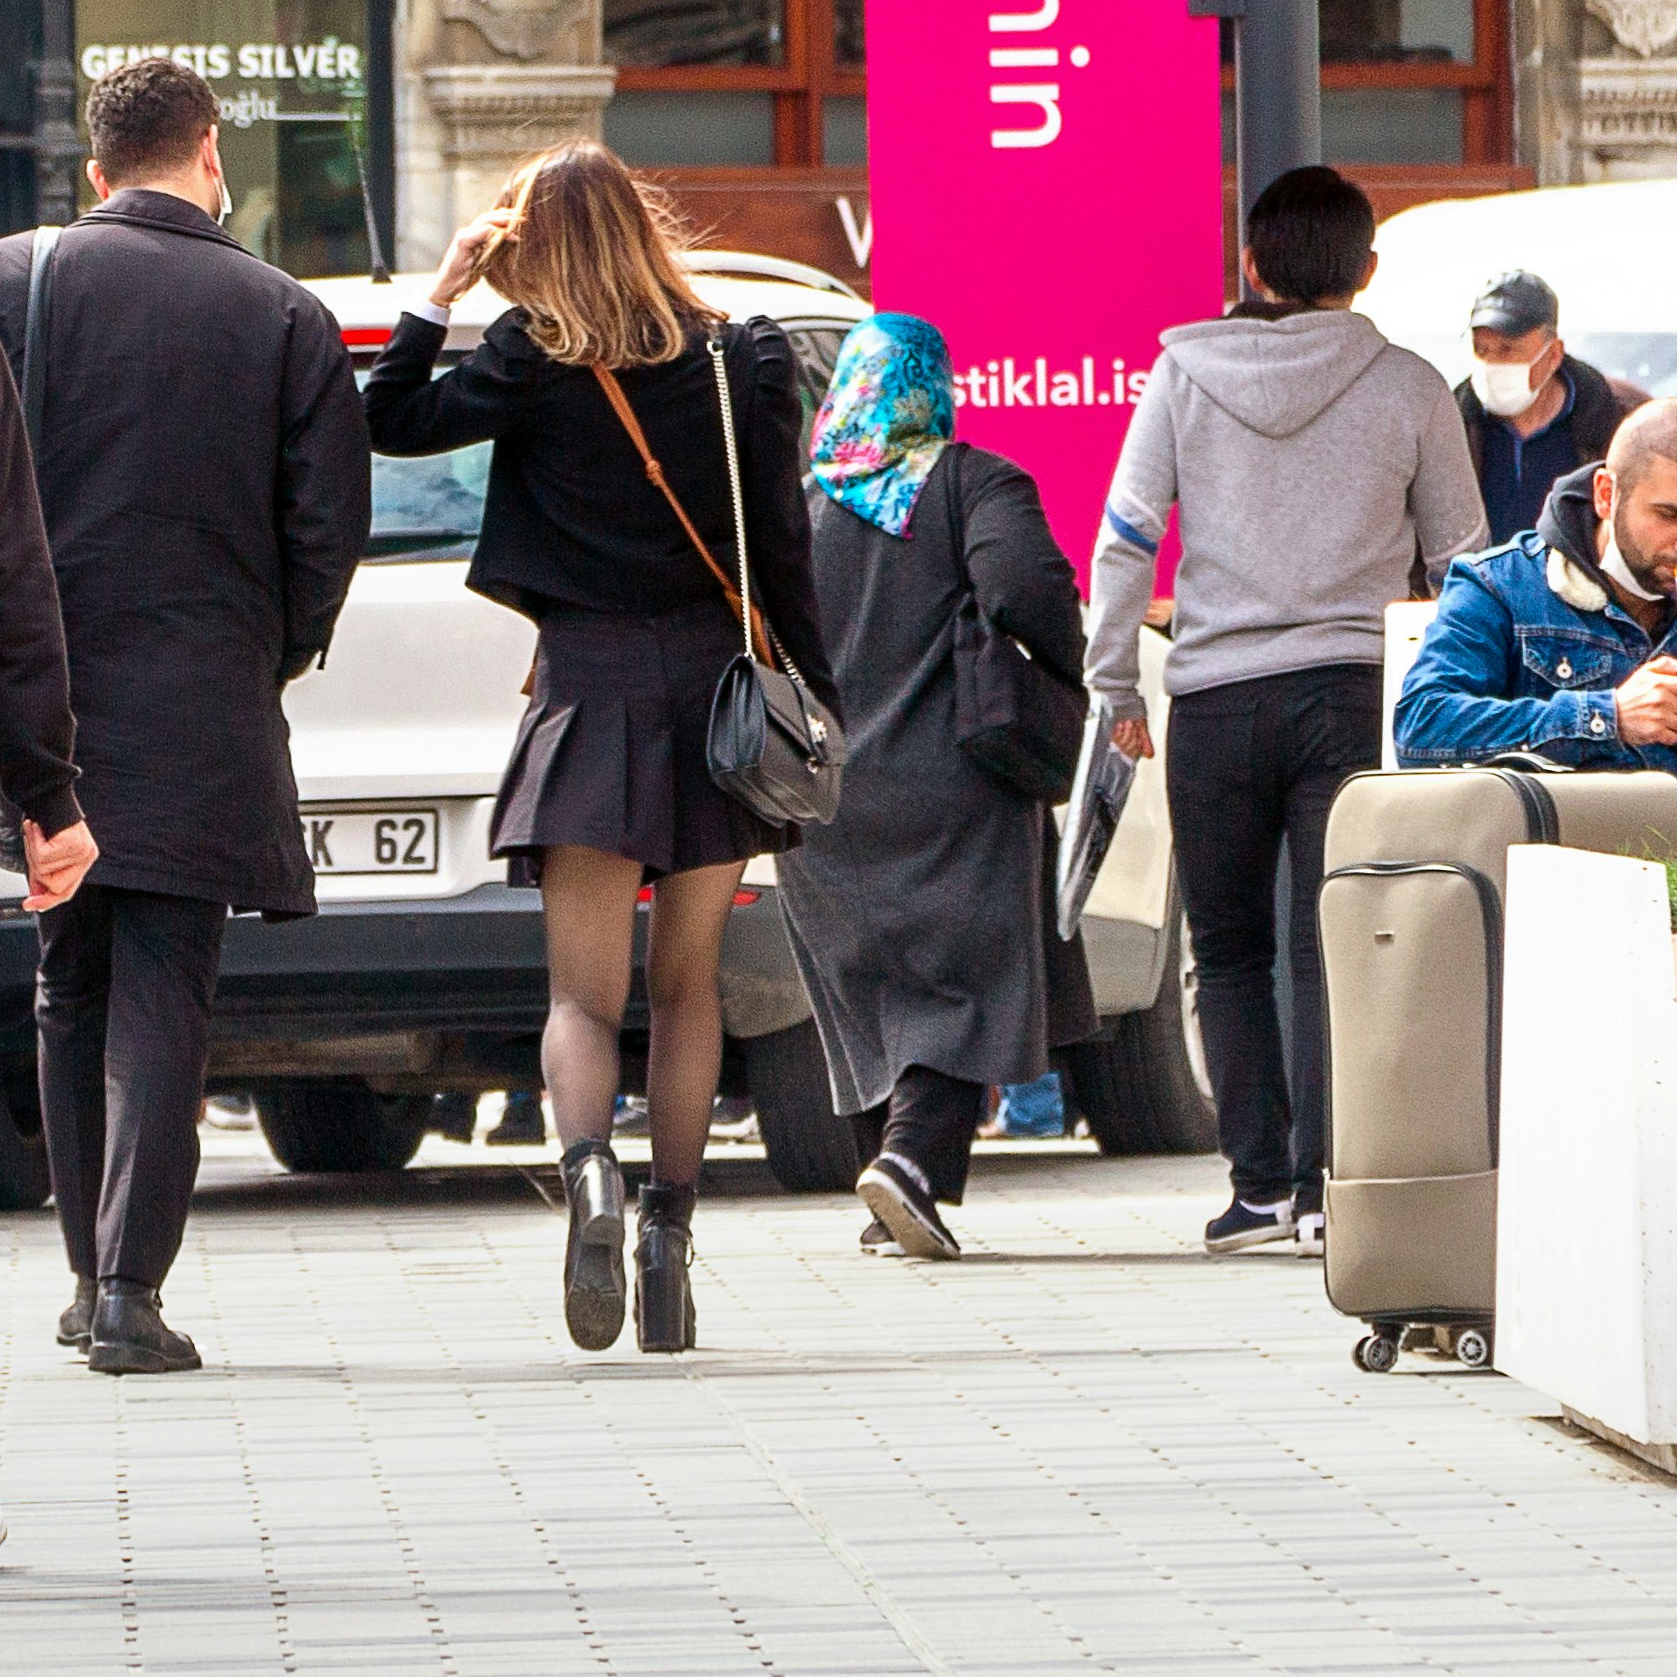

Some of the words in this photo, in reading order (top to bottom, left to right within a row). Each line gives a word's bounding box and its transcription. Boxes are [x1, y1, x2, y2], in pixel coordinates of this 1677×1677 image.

[238, 44, 363, 80] SILVER
[219, 88, 278, 128] oğlu
[374, 818, 427, 866] 62
